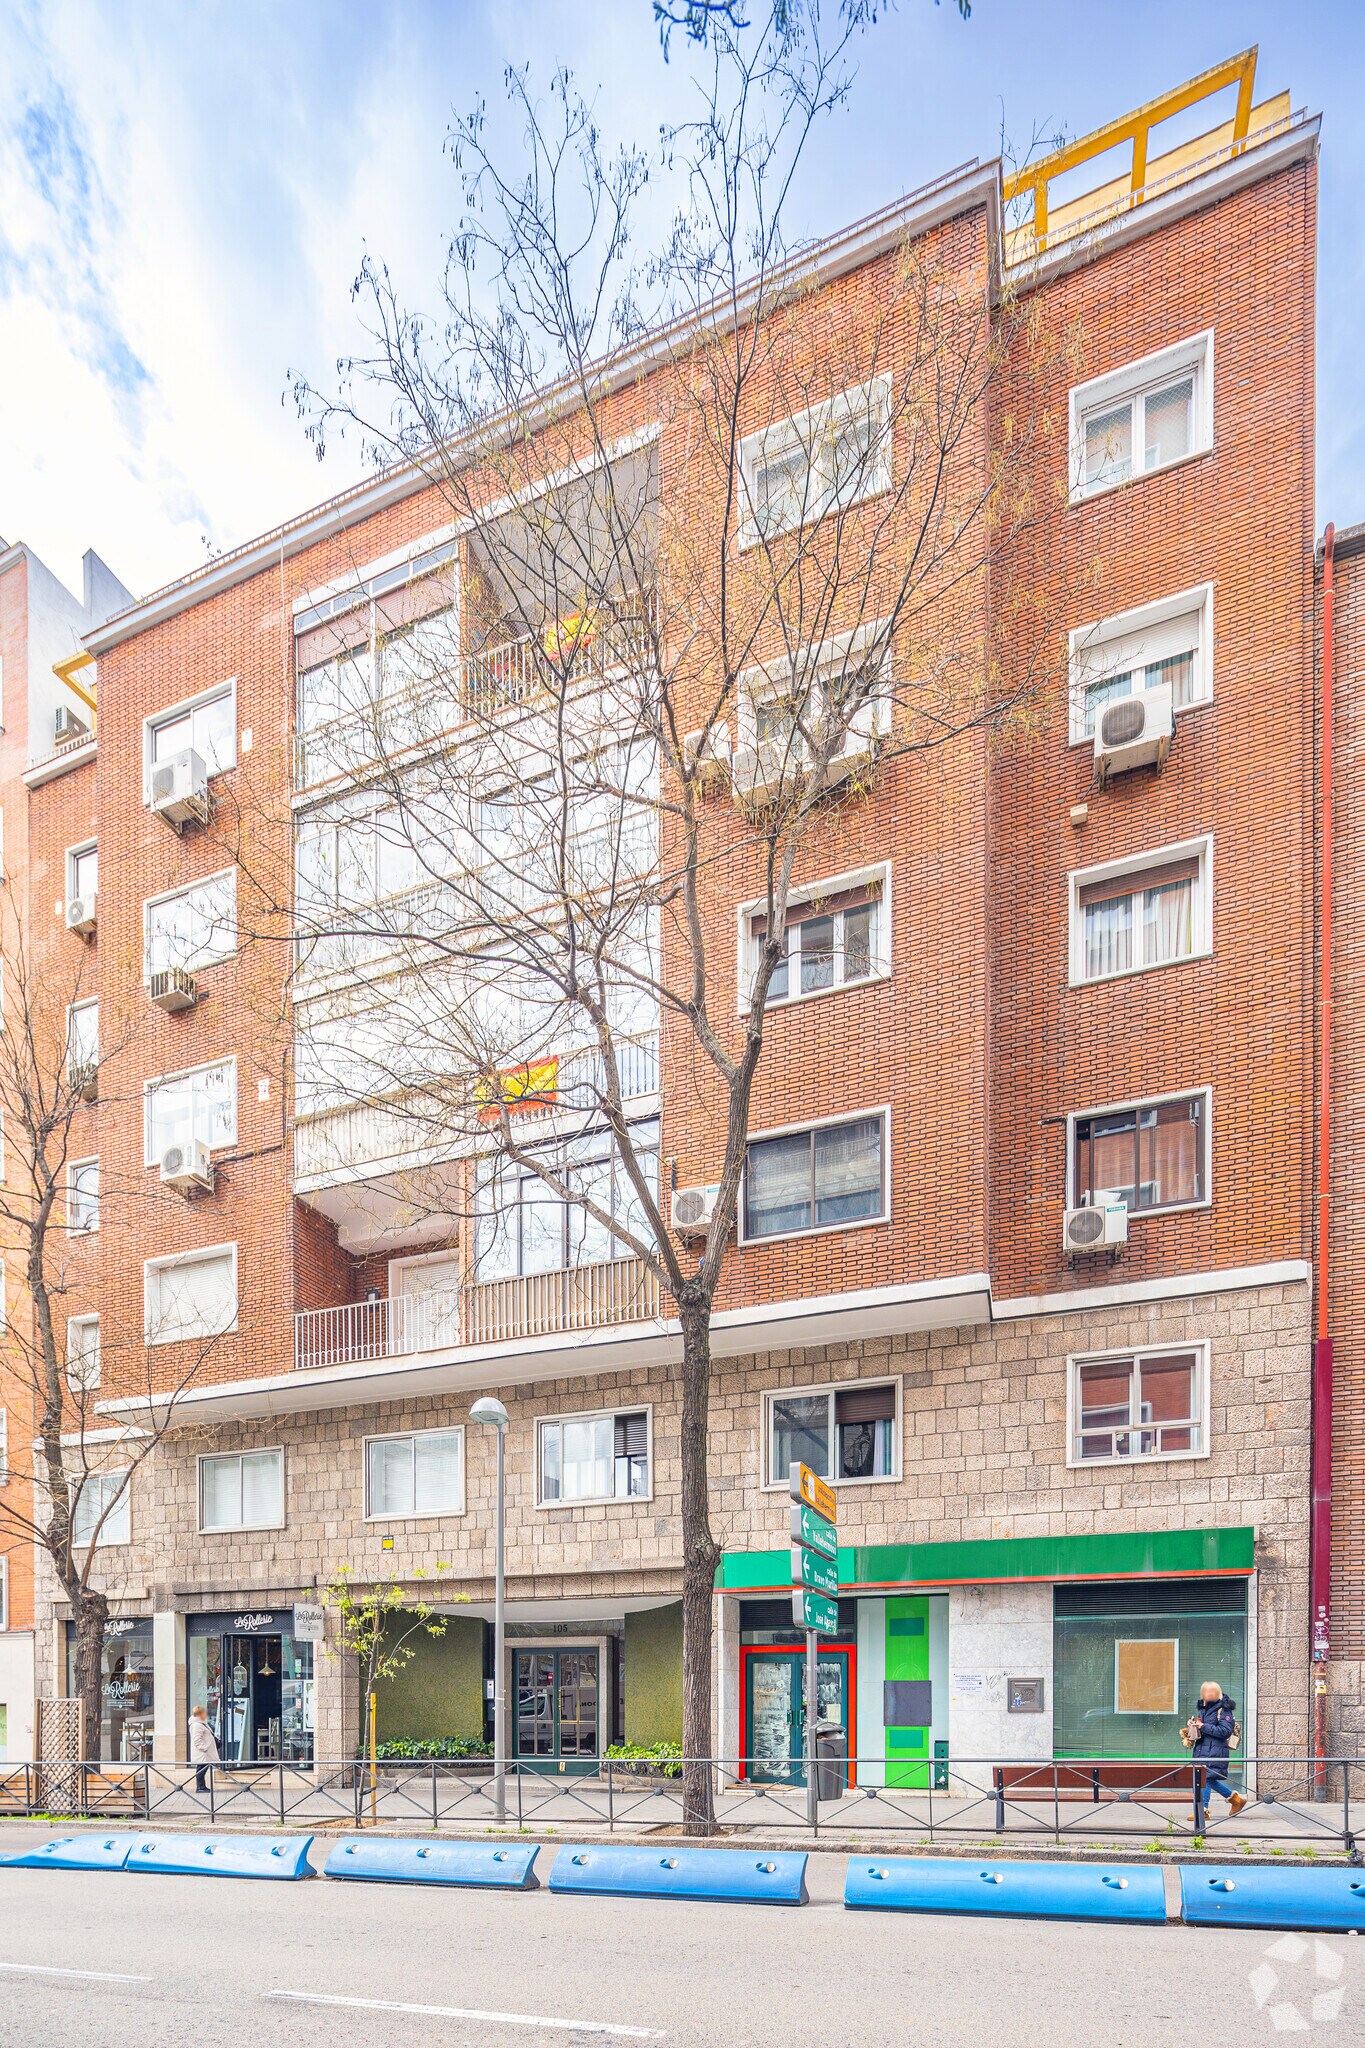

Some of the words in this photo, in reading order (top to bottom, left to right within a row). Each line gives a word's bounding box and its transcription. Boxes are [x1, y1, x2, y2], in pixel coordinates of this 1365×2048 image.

[814, 1570, 825, 1587] Bravo
[243, 1614, 274, 1631] Rollerie
[815, 1611, 824, 1626] José
[109, 1620, 135, 1637] Rollerie
[553, 1624, 568, 1633] 105
[109, 1680, 141, 1700] Rollerie
